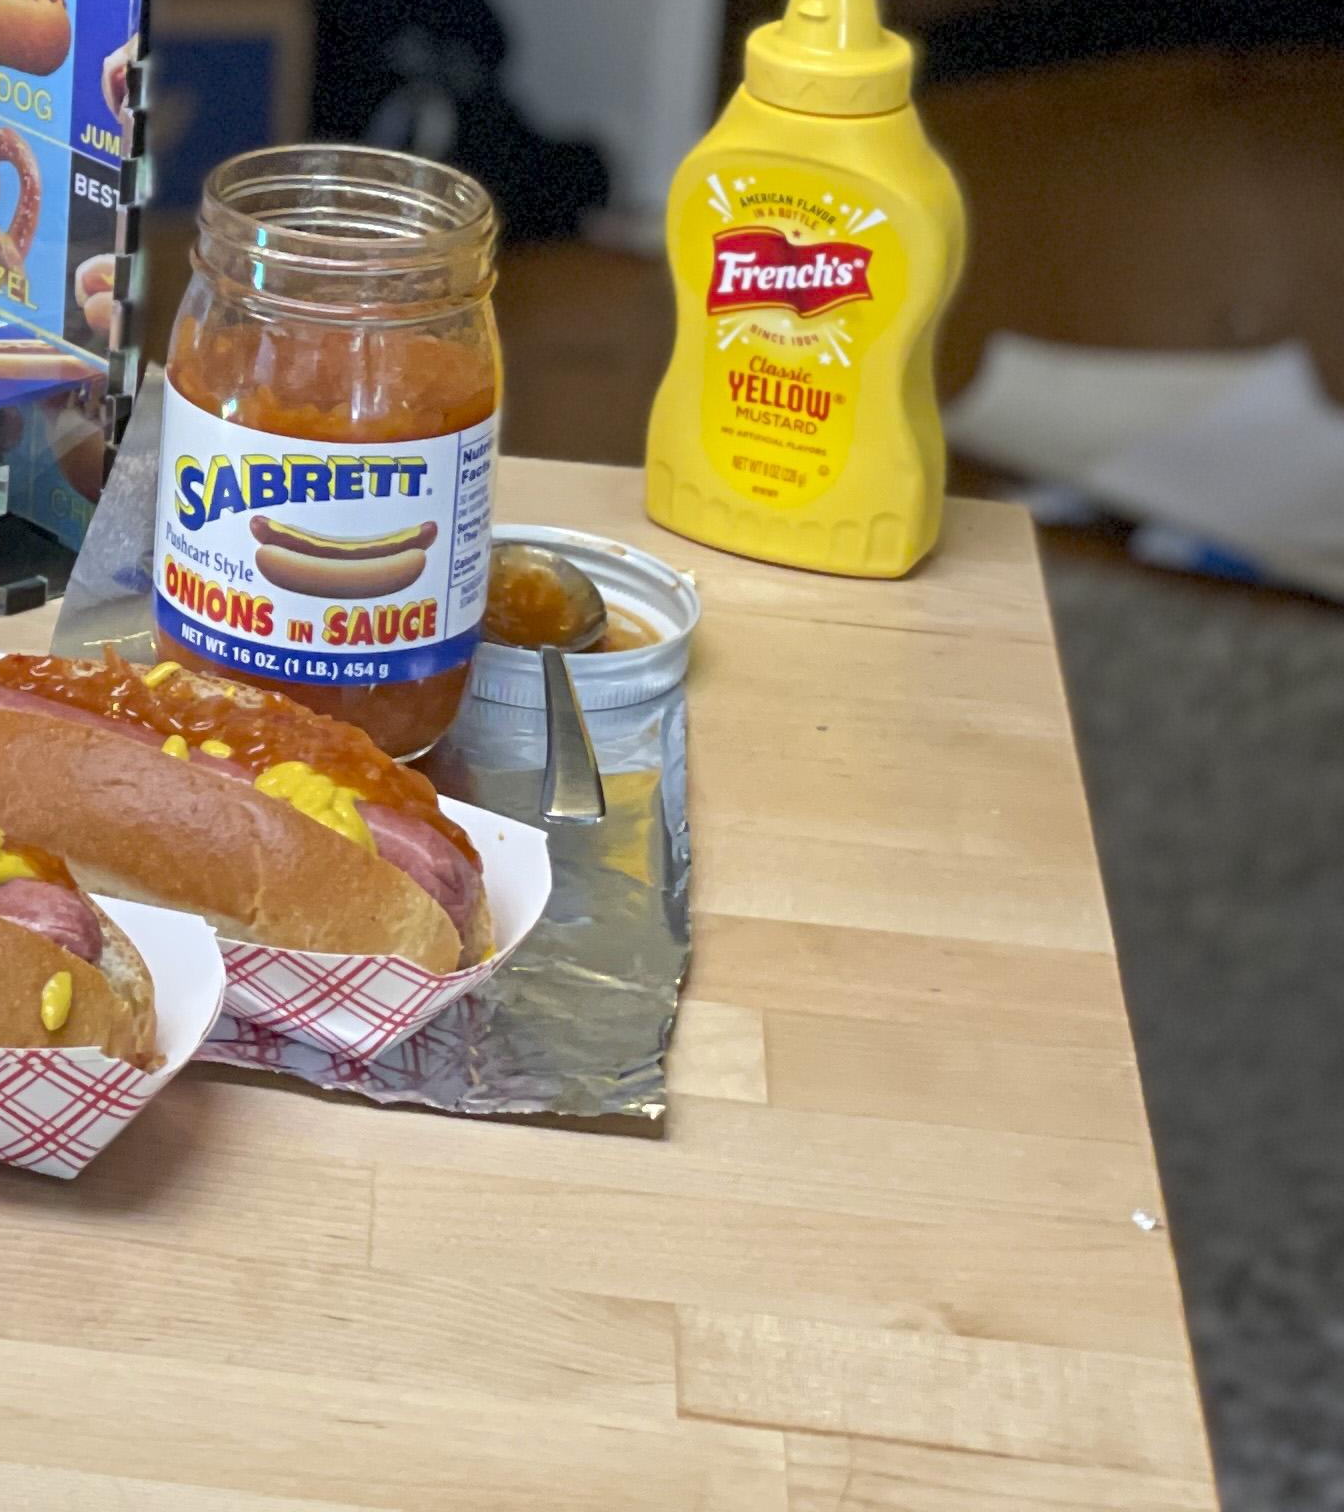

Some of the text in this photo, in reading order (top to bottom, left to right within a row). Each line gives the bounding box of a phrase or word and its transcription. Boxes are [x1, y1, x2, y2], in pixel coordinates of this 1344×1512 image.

[80, 123, 121, 157] JUM
[739, 192, 837, 226] AMERICAN FLAVOR
[778, 207, 820, 231] BOTTLE
[717, 251, 853, 295] French's
[749, 355, 813, 384] Classic
[728, 370, 832, 422] YELLOW
[735, 405, 818, 436] MUSTARD
[174, 453, 428, 532] SABRETT
[165, 520, 255, 584] Pushcart Style
[164, 552, 439, 647] ONIONS IN SAUCE
[180, 622, 390, 679] NET WT. 16 OZ. (1 LB.) 454 g
